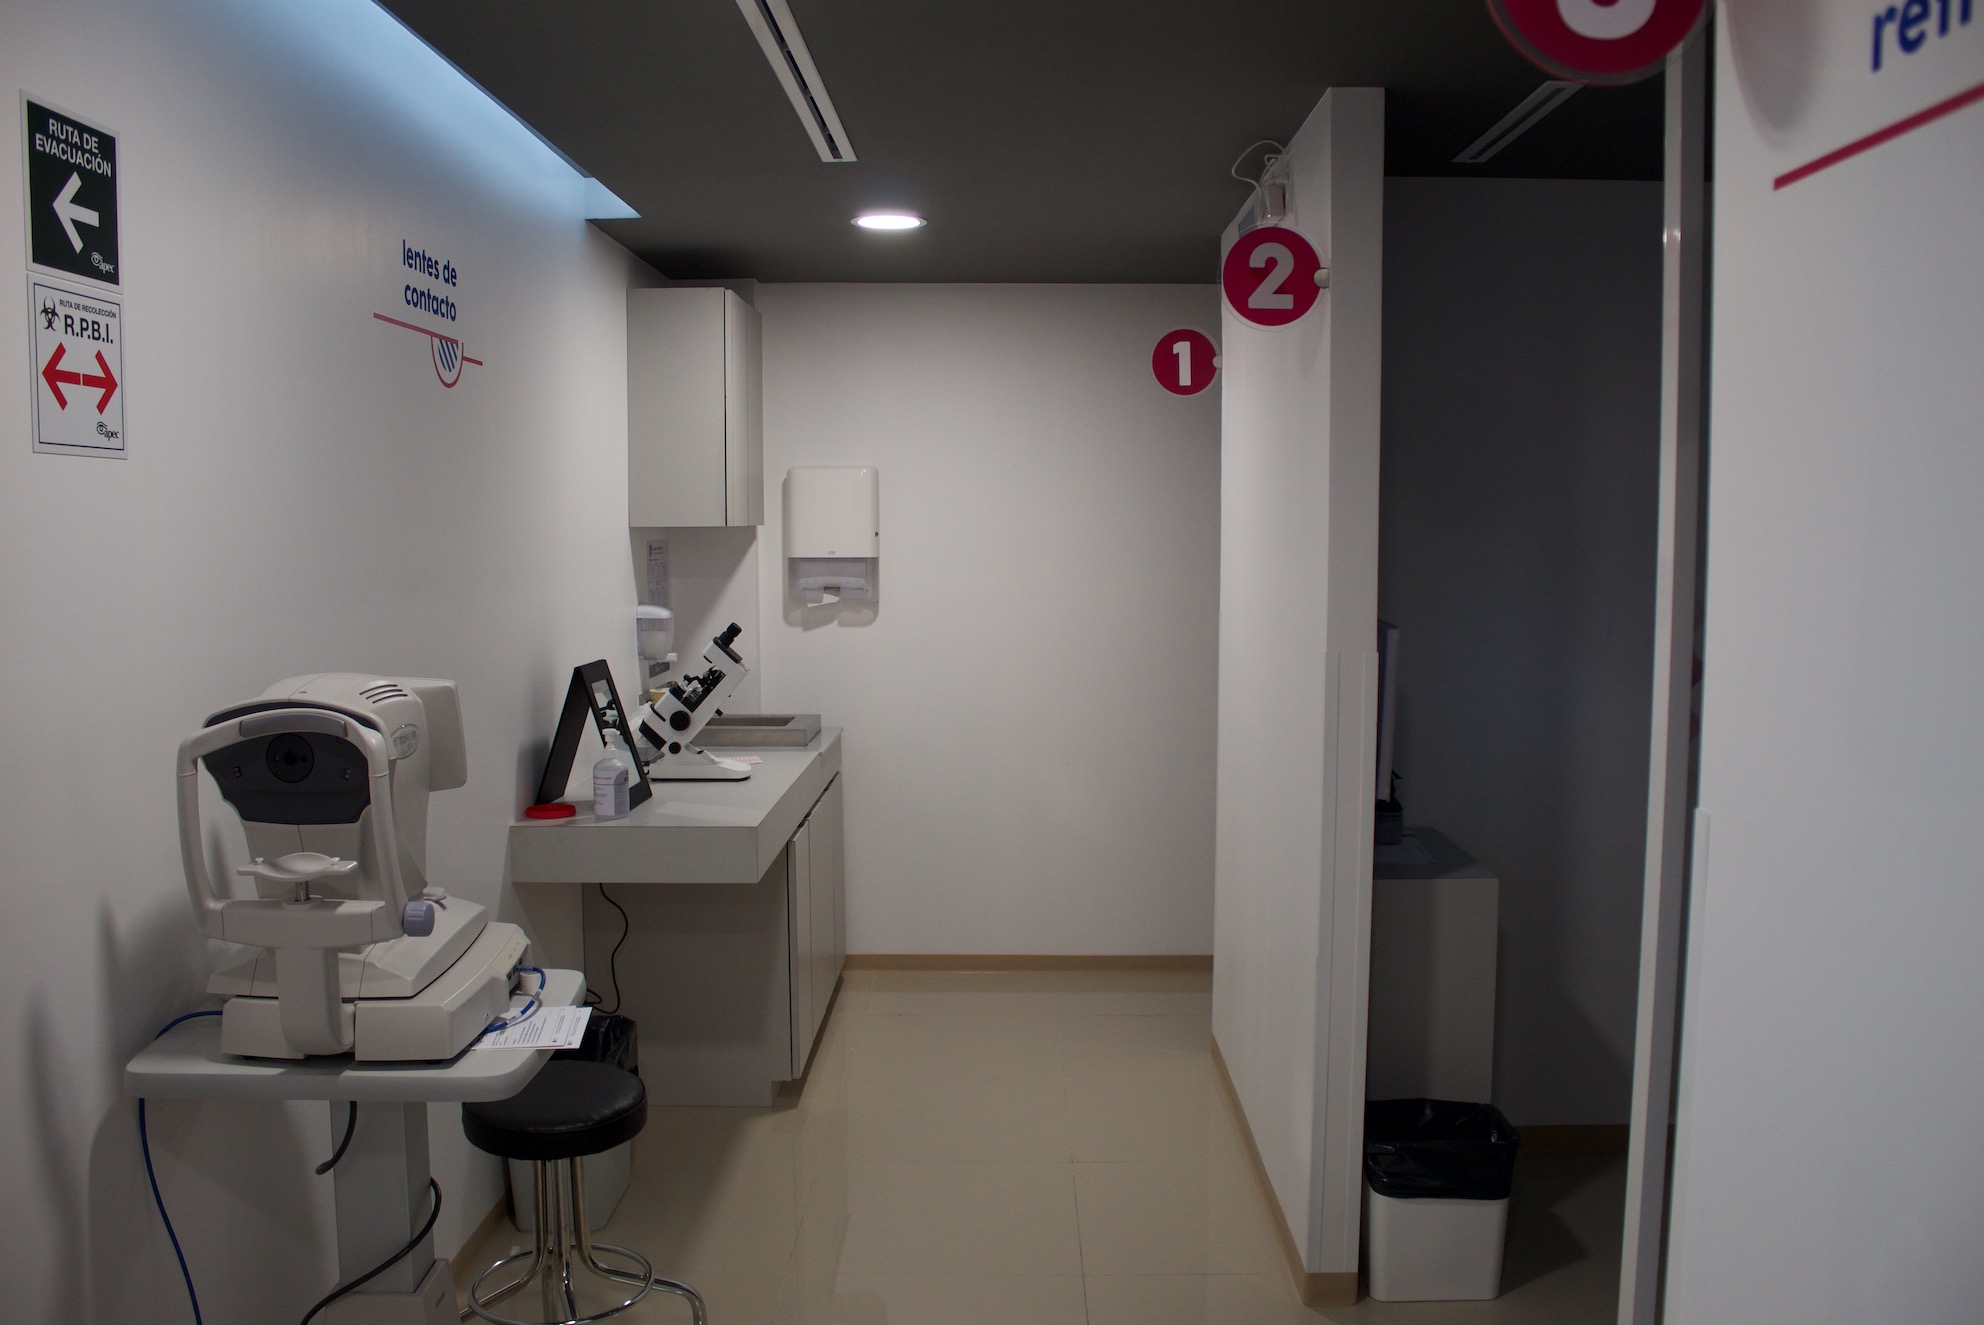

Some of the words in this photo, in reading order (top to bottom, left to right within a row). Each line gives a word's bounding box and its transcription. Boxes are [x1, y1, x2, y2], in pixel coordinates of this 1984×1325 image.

[35, 133, 112, 177] EVACUACIÓN
[49, 118, 80, 147] RUTA
[83, 132, 99, 153] DE
[402, 239, 439, 280] lentes
[443, 260, 457, 287] de
[1248, 242, 1294, 309] 2
[59, 299, 73, 310] RUTA
[74, 302, 81, 311] DE
[81, 303, 117, 319] RECOLECCIÓN
[404, 284, 457, 322] contacto
[64, 314, 113, 344] R.P.B.I.
[1172, 341, 1191, 387] 1
